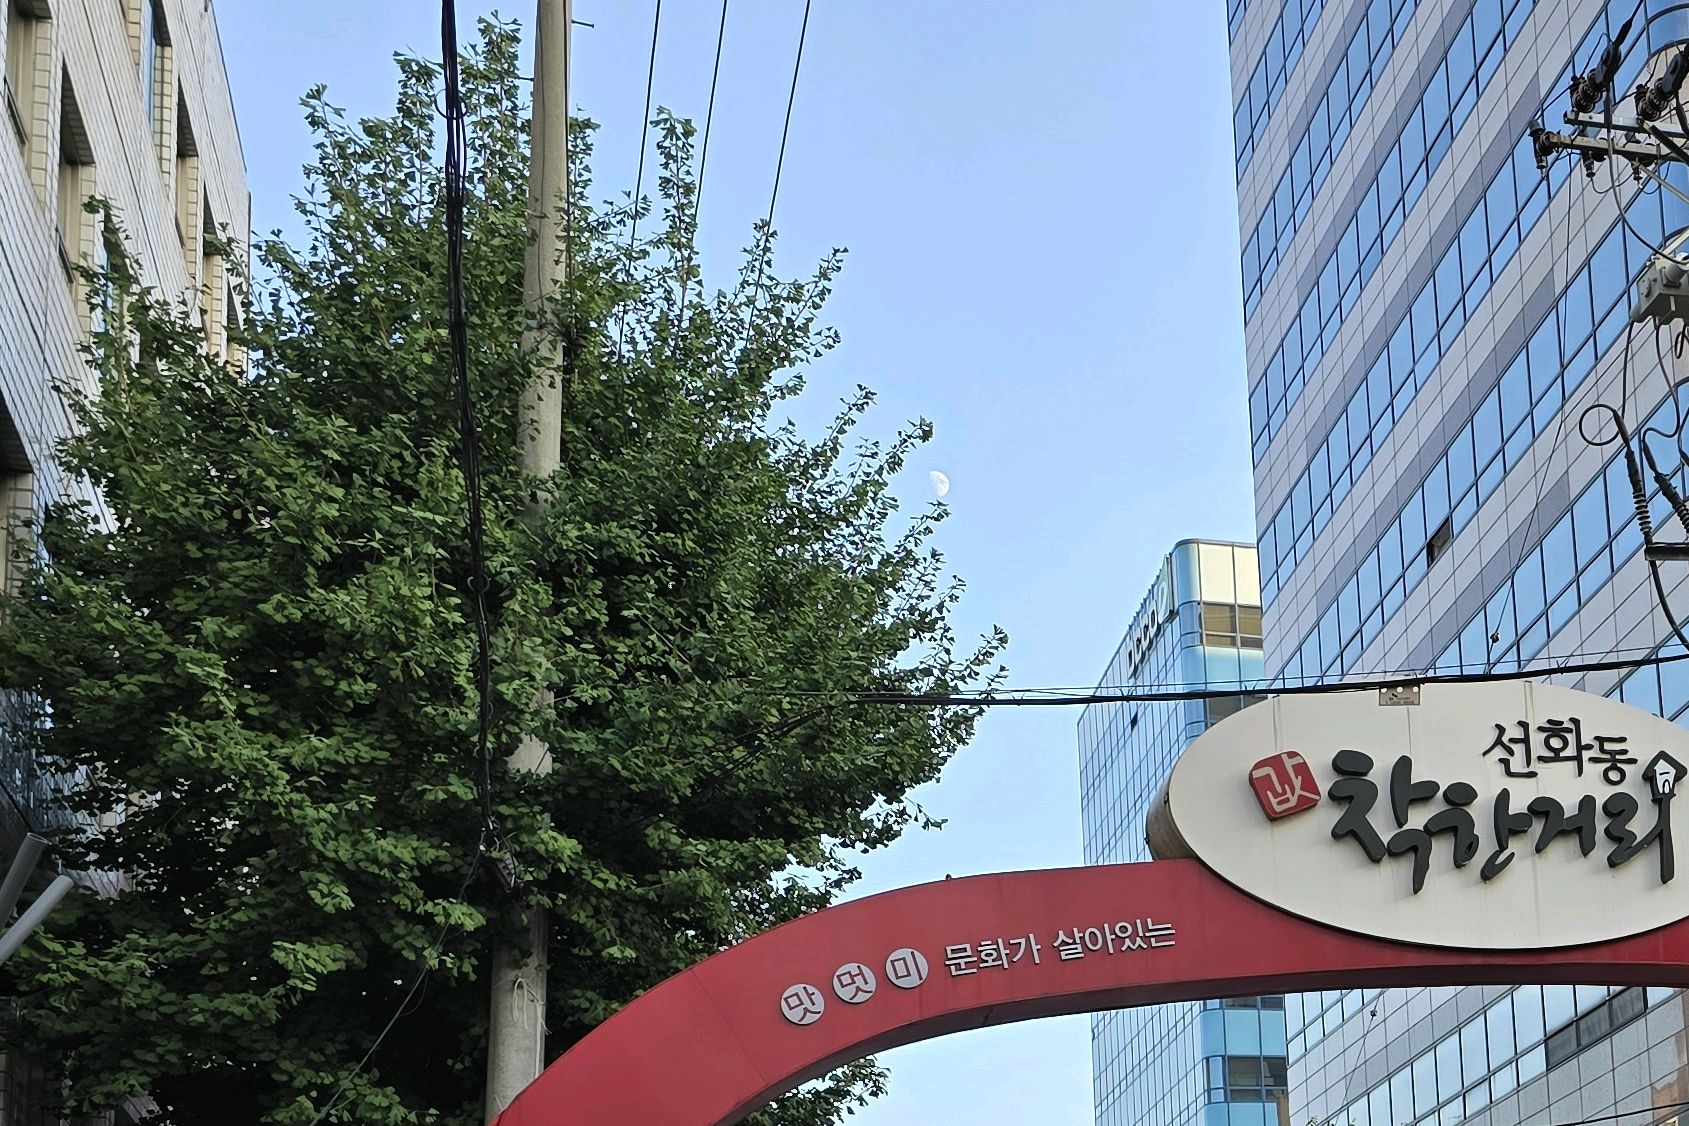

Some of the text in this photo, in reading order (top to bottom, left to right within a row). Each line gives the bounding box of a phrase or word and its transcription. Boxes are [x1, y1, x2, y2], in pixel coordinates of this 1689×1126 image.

[1483, 716, 1638, 785] 선화동
[889, 950, 924, 983] 미
[944, 932, 1042, 977] 문화가
[1052, 917, 1176, 960] 살아있는
